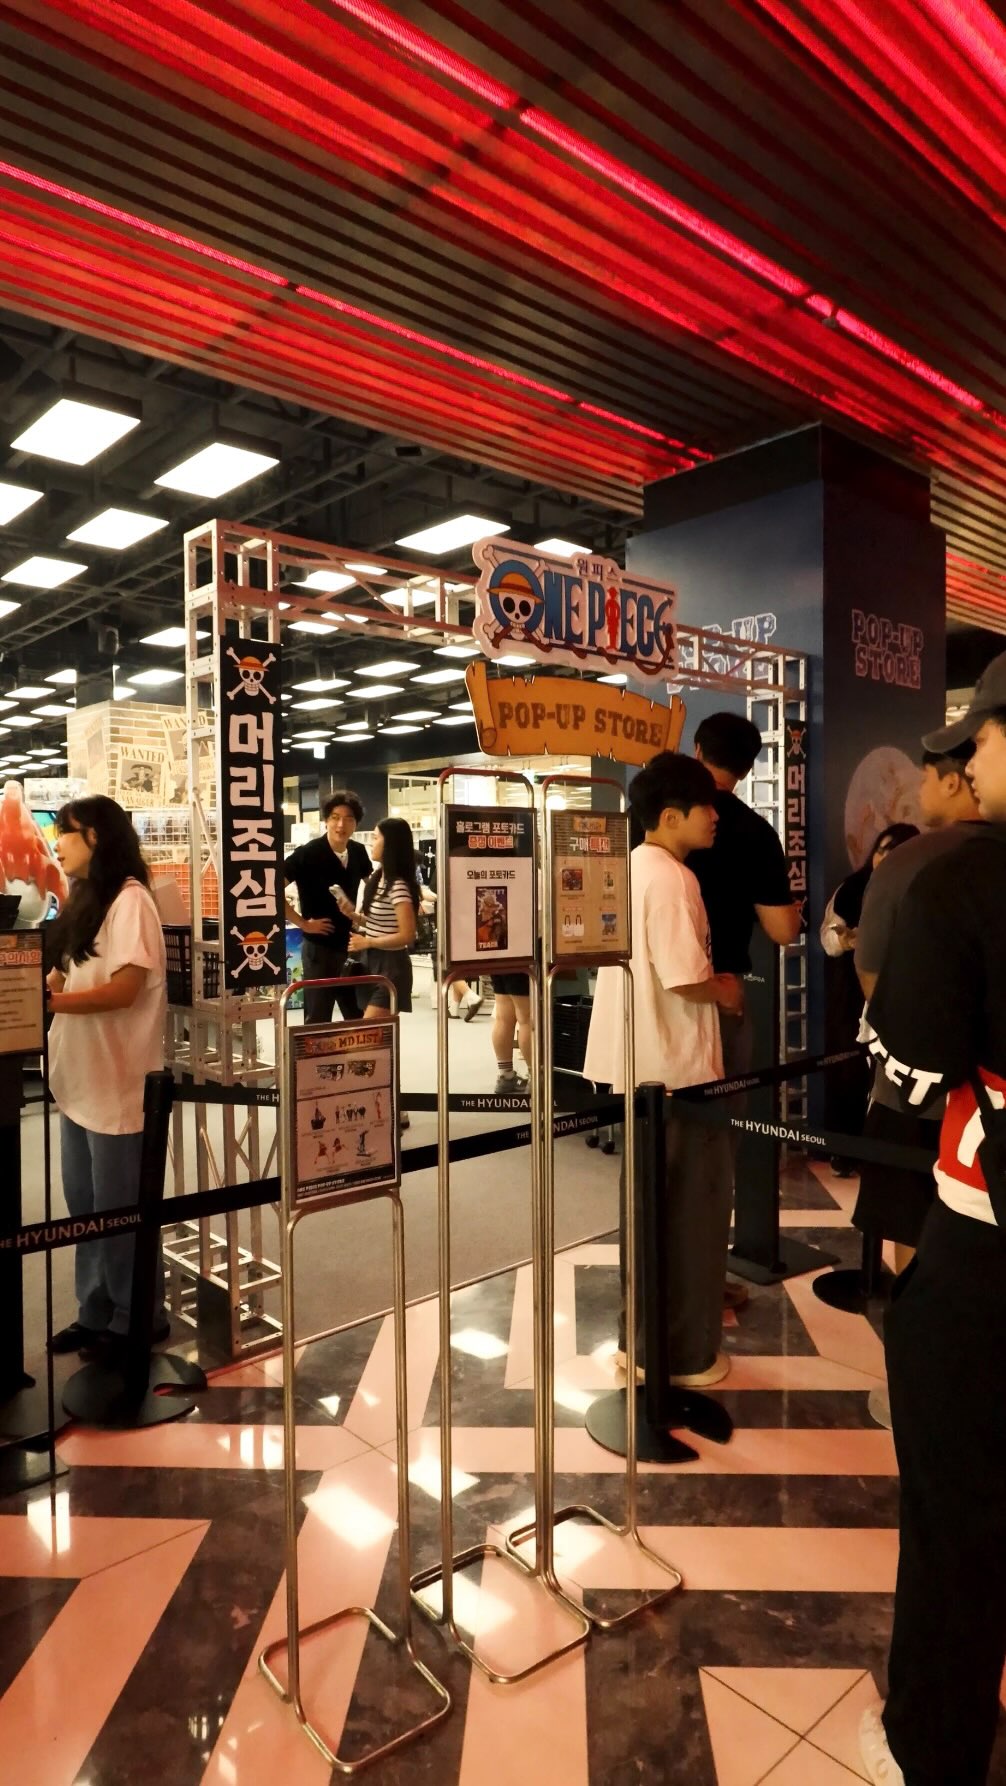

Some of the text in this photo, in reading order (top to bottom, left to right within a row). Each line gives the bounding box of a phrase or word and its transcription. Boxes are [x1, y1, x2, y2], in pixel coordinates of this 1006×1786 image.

[577, 558, 620, 583] 원피스
[489, 560, 674, 664] ONE PIECE
[852, 609, 924, 656] POP-UP
[855, 643, 921, 689] STORE
[499, 701, 663, 747] POP-UP STORE
[120, 745, 165, 763] WANTED
[229, 711, 277, 918] 머리조심
[456, 821, 525, 834] 홀로그램 포토카드
[487, 835, 514, 849] 이벤트
[466, 870, 516, 880] 오늘의 포토카드
[338, 1036, 355, 1049] MD
[356, 1033, 380, 1045] LIST
[714, 1079, 747, 1095] HYUNDAI
[579, 1115, 599, 1126] SEOUL
[731, 1118, 827, 1146] THE HYUNDAI SEOUL
[17, 1218, 104, 1248] HYUNDAI
[107, 1213, 142, 1228] SEOUL
